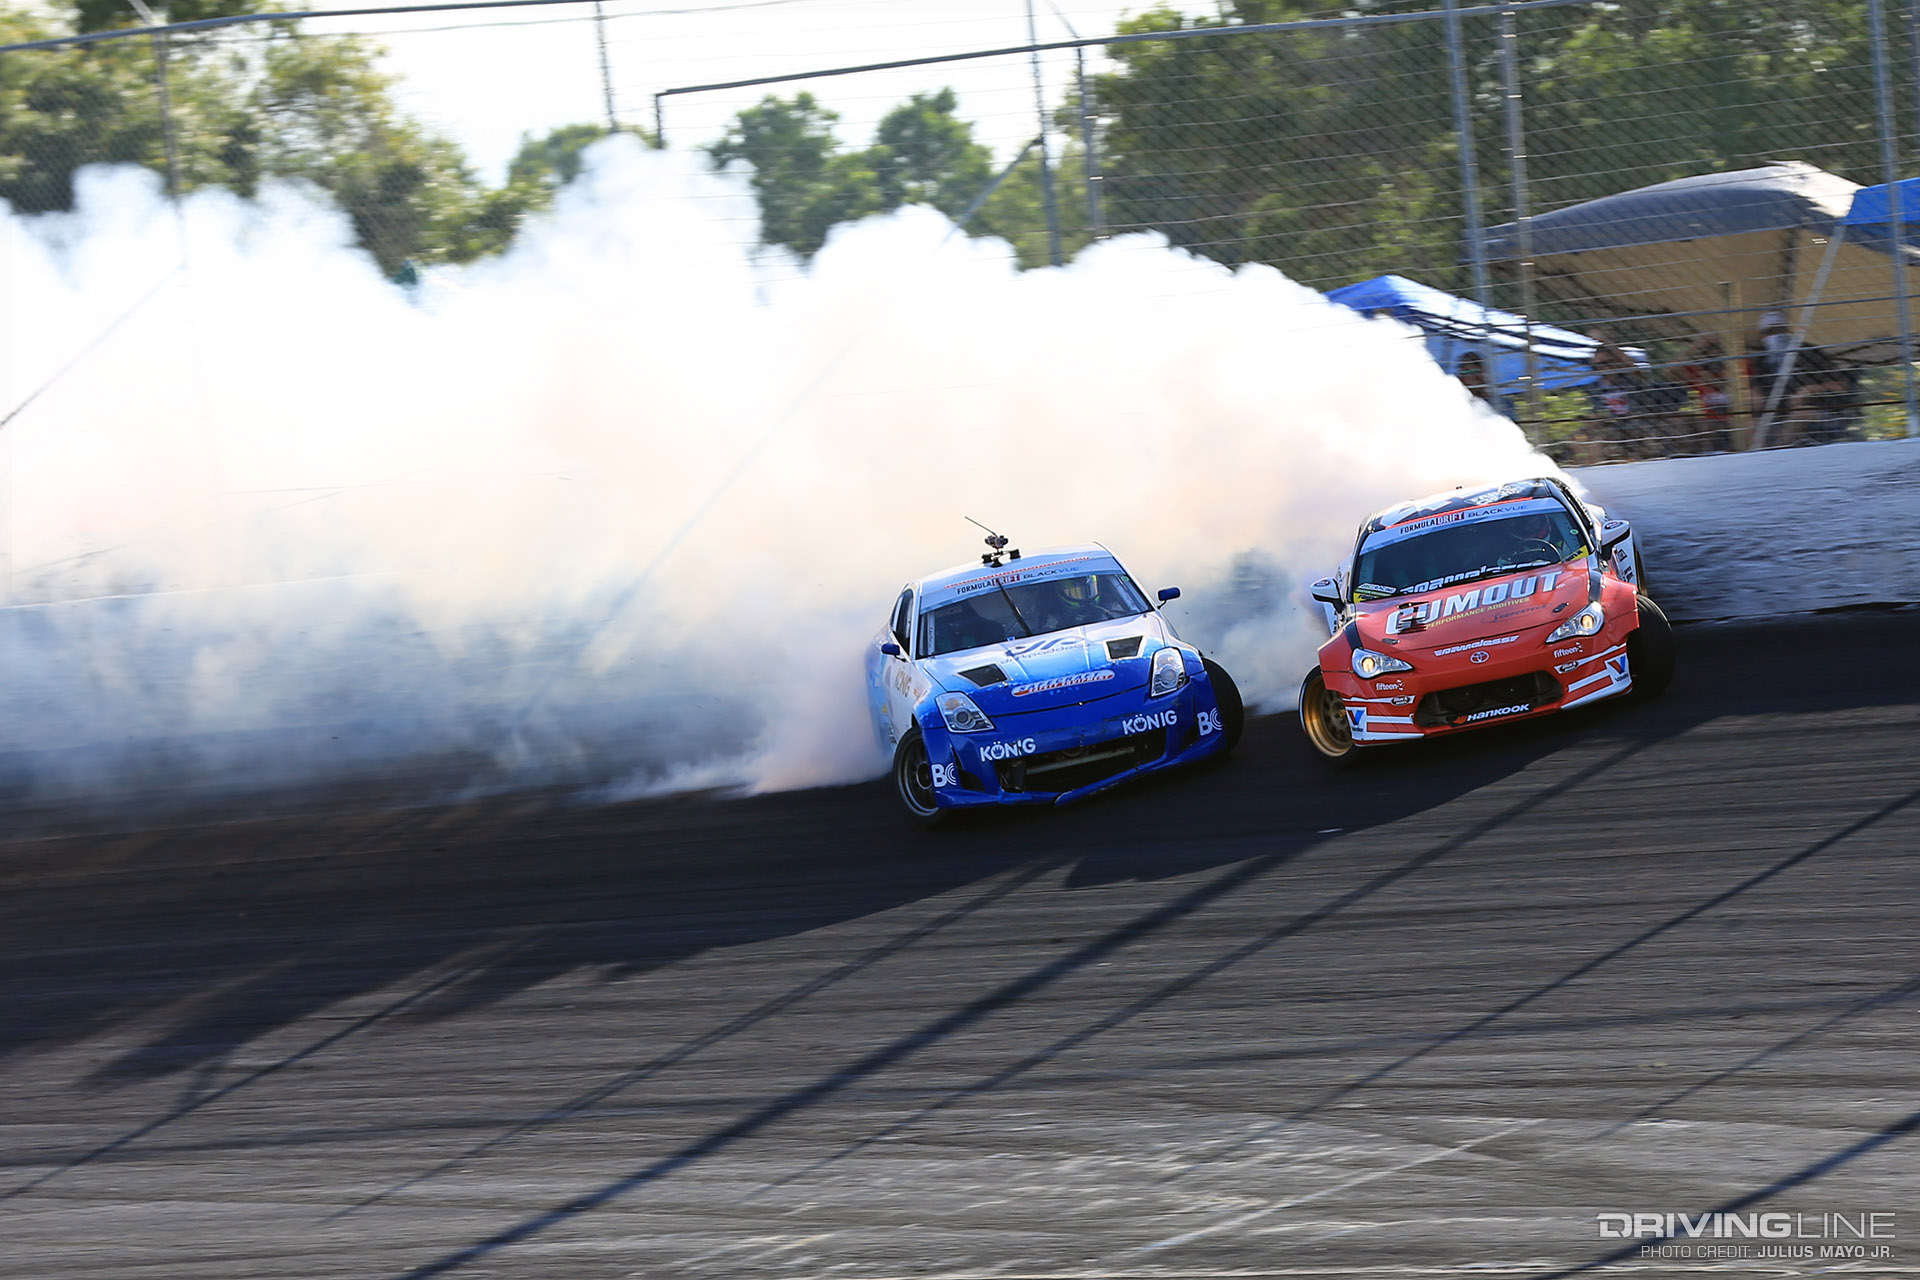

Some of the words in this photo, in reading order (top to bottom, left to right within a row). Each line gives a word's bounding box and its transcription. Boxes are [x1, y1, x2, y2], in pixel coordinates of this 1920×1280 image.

[1400, 519, 1435, 534] FORMULA
[1467, 505, 1528, 518] BLACKVUE
[957, 581, 992, 595] FORMULA
[1023, 566, 1080, 579] BLACKVUE
[1425, 606, 1486, 630] PERFORMANCE
[1487, 597, 1530, 611] ADDITIVES
[1122, 710, 1177, 735] KÖNIG
[980, 738, 1036, 762] KÖNIG
